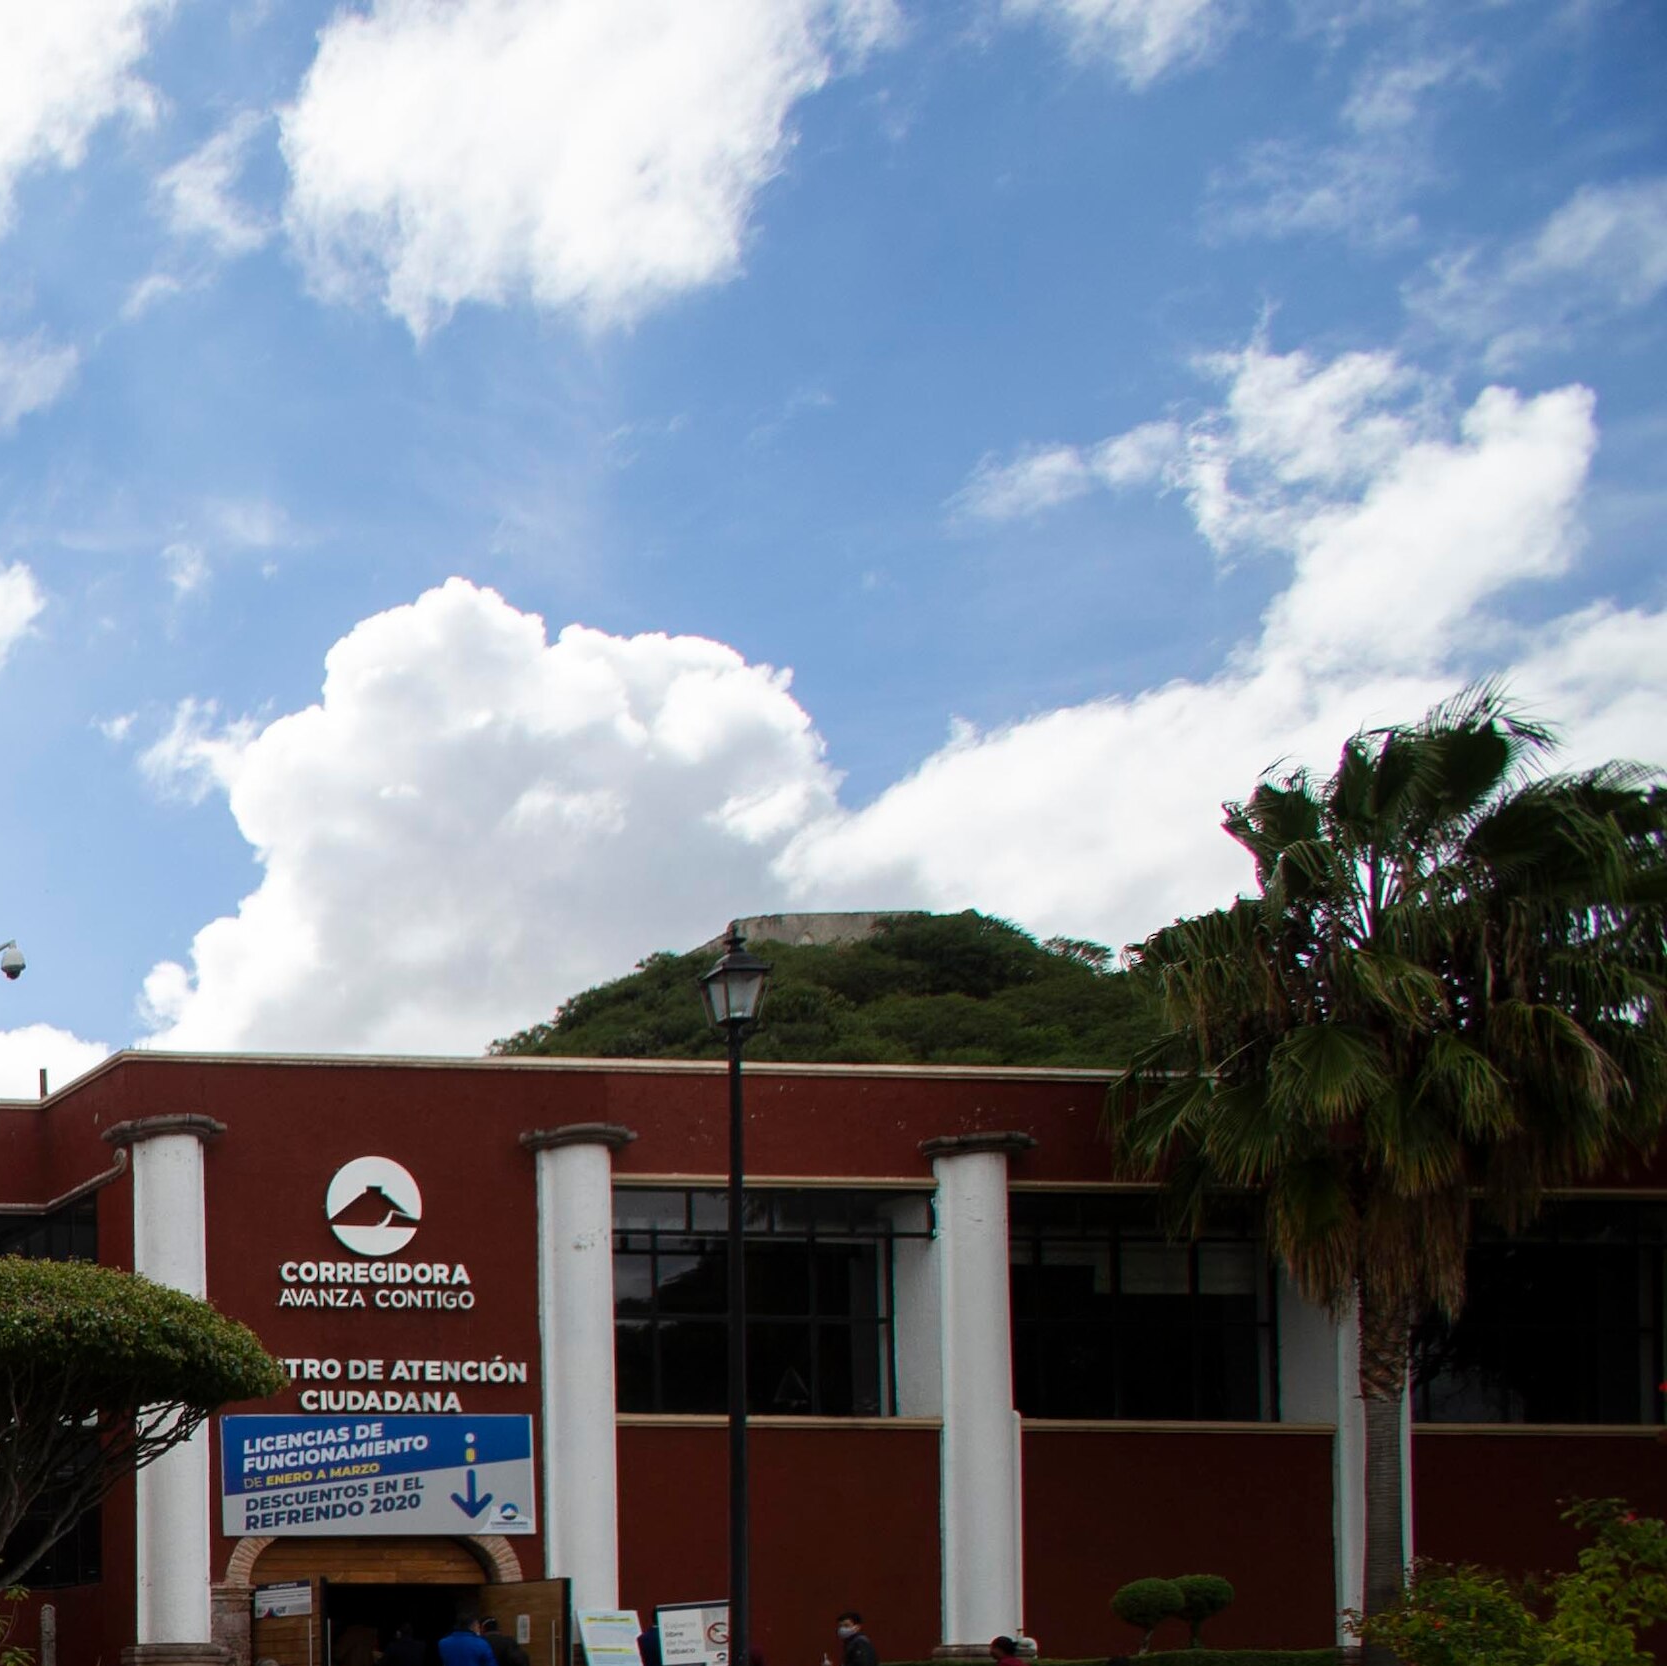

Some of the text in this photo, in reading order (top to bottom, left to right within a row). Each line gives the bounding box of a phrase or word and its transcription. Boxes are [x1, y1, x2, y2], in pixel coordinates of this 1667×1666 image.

[280, 1262, 470, 1285] CORREGIDORA
[279, 1288, 475, 1309] AVANZA CONTIGO
[348, 1359, 384, 1380] DE
[390, 1355, 527, 1383] ATENCIÓN
[301, 1389, 463, 1412] CIUDADANA
[243, 1423, 383, 1455] LICENCIAS DE
[242, 1434, 429, 1473] FUNCIONAMIENTO
[243, 1462, 380, 1489] DE ENERO A MARZO
[245, 1476, 425, 1512] DESCUENTOS EN EL
[245, 1493, 421, 1531] REFRENDO 2020
